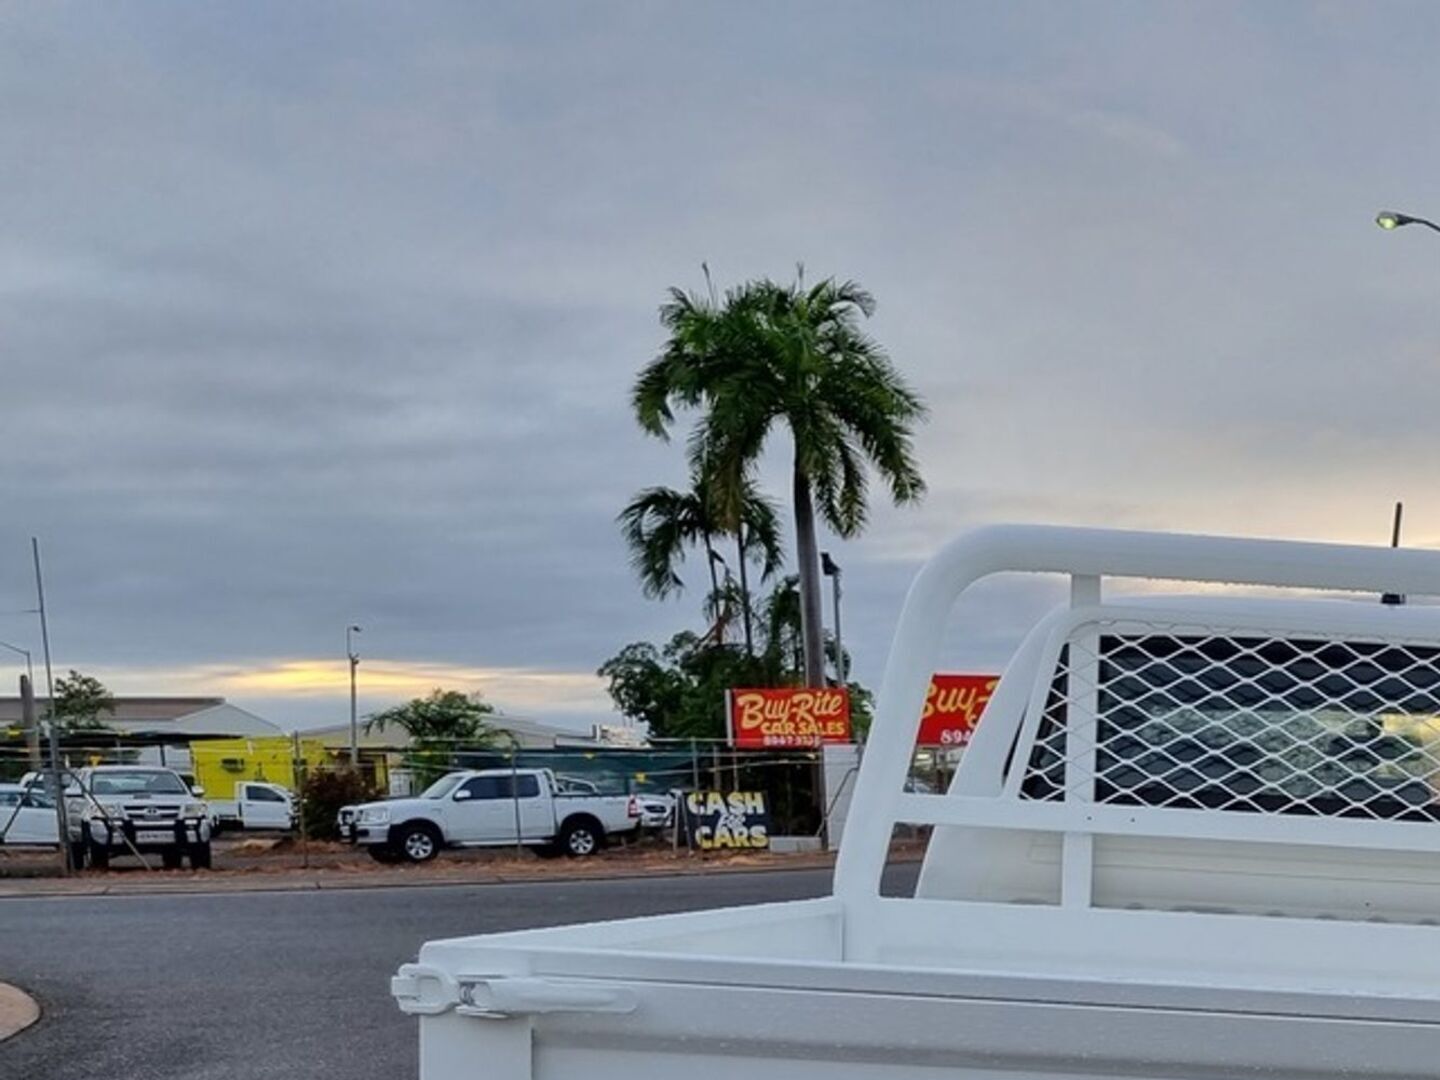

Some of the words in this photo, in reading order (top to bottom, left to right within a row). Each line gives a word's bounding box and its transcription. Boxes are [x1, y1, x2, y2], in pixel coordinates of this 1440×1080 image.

[761, 721, 796, 736] CAR
[798, 721, 845, 735] SALES
[687, 791, 765, 816] CASH
[695, 825, 769, 849] CARS
